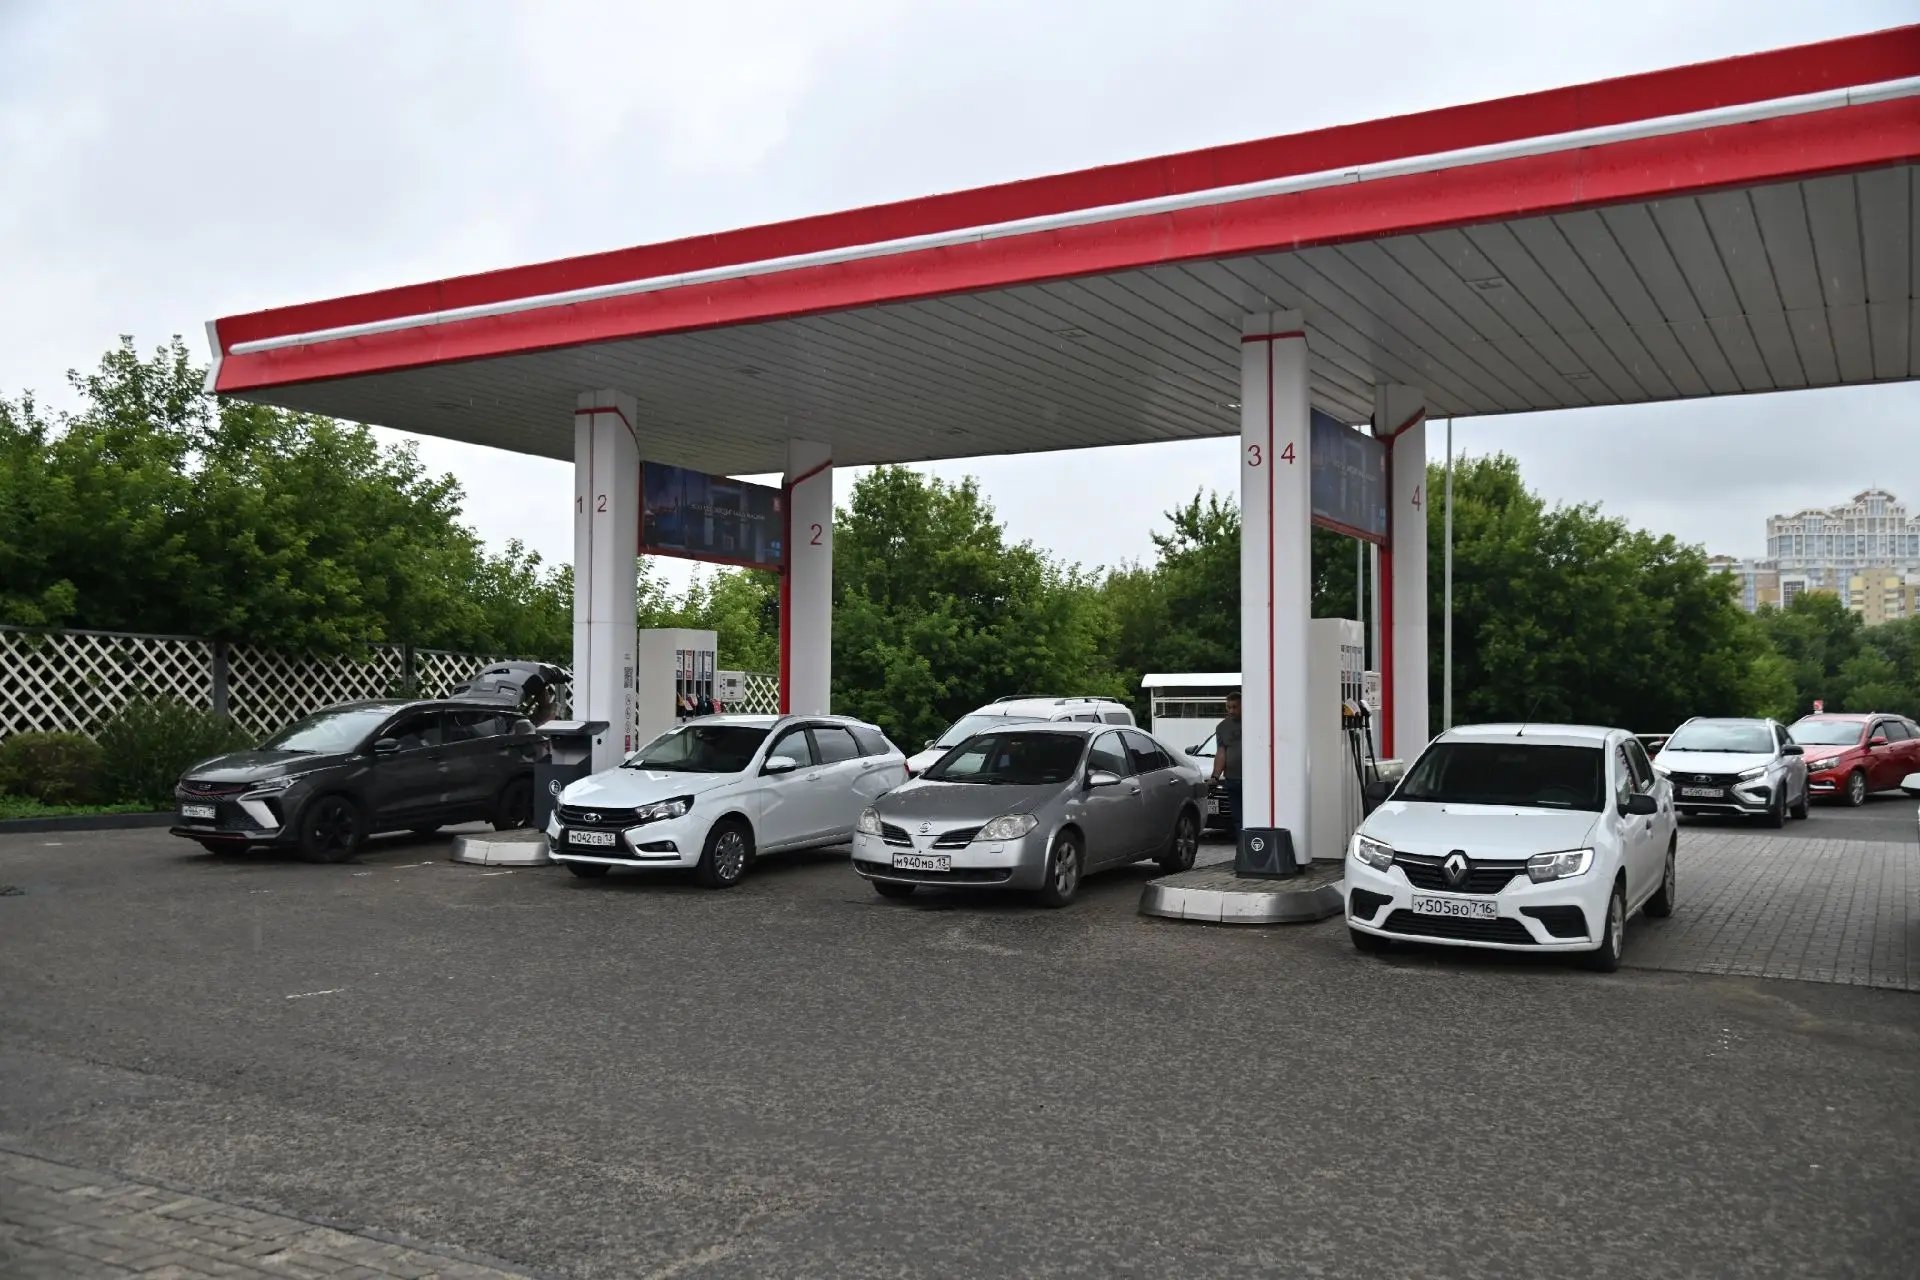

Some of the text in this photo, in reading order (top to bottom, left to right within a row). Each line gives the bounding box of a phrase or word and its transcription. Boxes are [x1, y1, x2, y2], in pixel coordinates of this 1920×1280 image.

[1247, 442, 1295, 467] 3 4
[576, 494, 607, 514] 1 2
[1411, 484, 1422, 512] 4
[810, 523, 822, 545] 2
[1417, 899, 1493, 916] У505ВО 716
